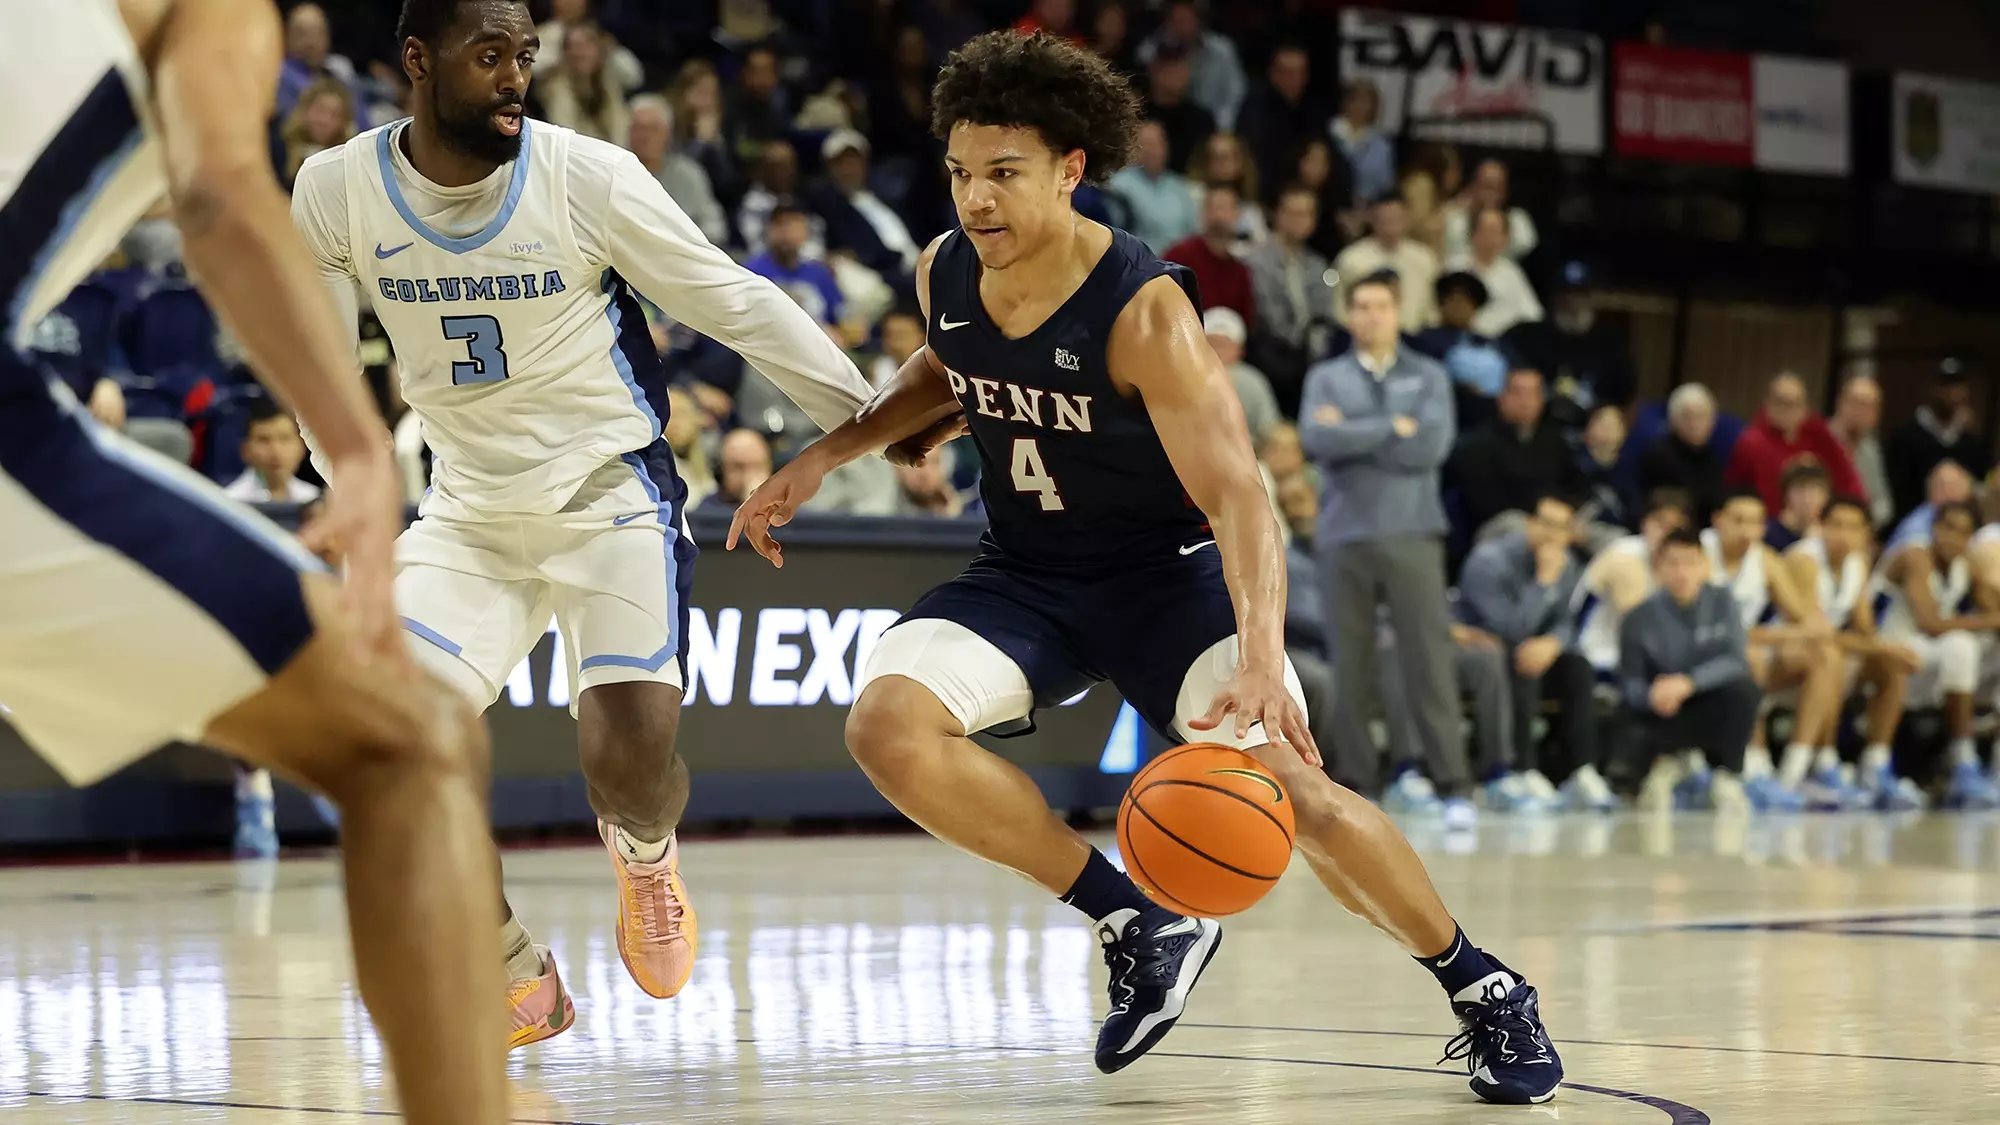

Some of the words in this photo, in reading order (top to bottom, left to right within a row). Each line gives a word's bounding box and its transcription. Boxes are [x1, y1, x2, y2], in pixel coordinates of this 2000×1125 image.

[513, 243, 533, 255] Ivy
[378, 270, 566, 303] COLUMBIA
[440, 314, 511, 386] 3
[1061, 354, 1080, 366] IVY
[943, 364, 1093, 433] PENN
[1010, 437, 1066, 512] 4
